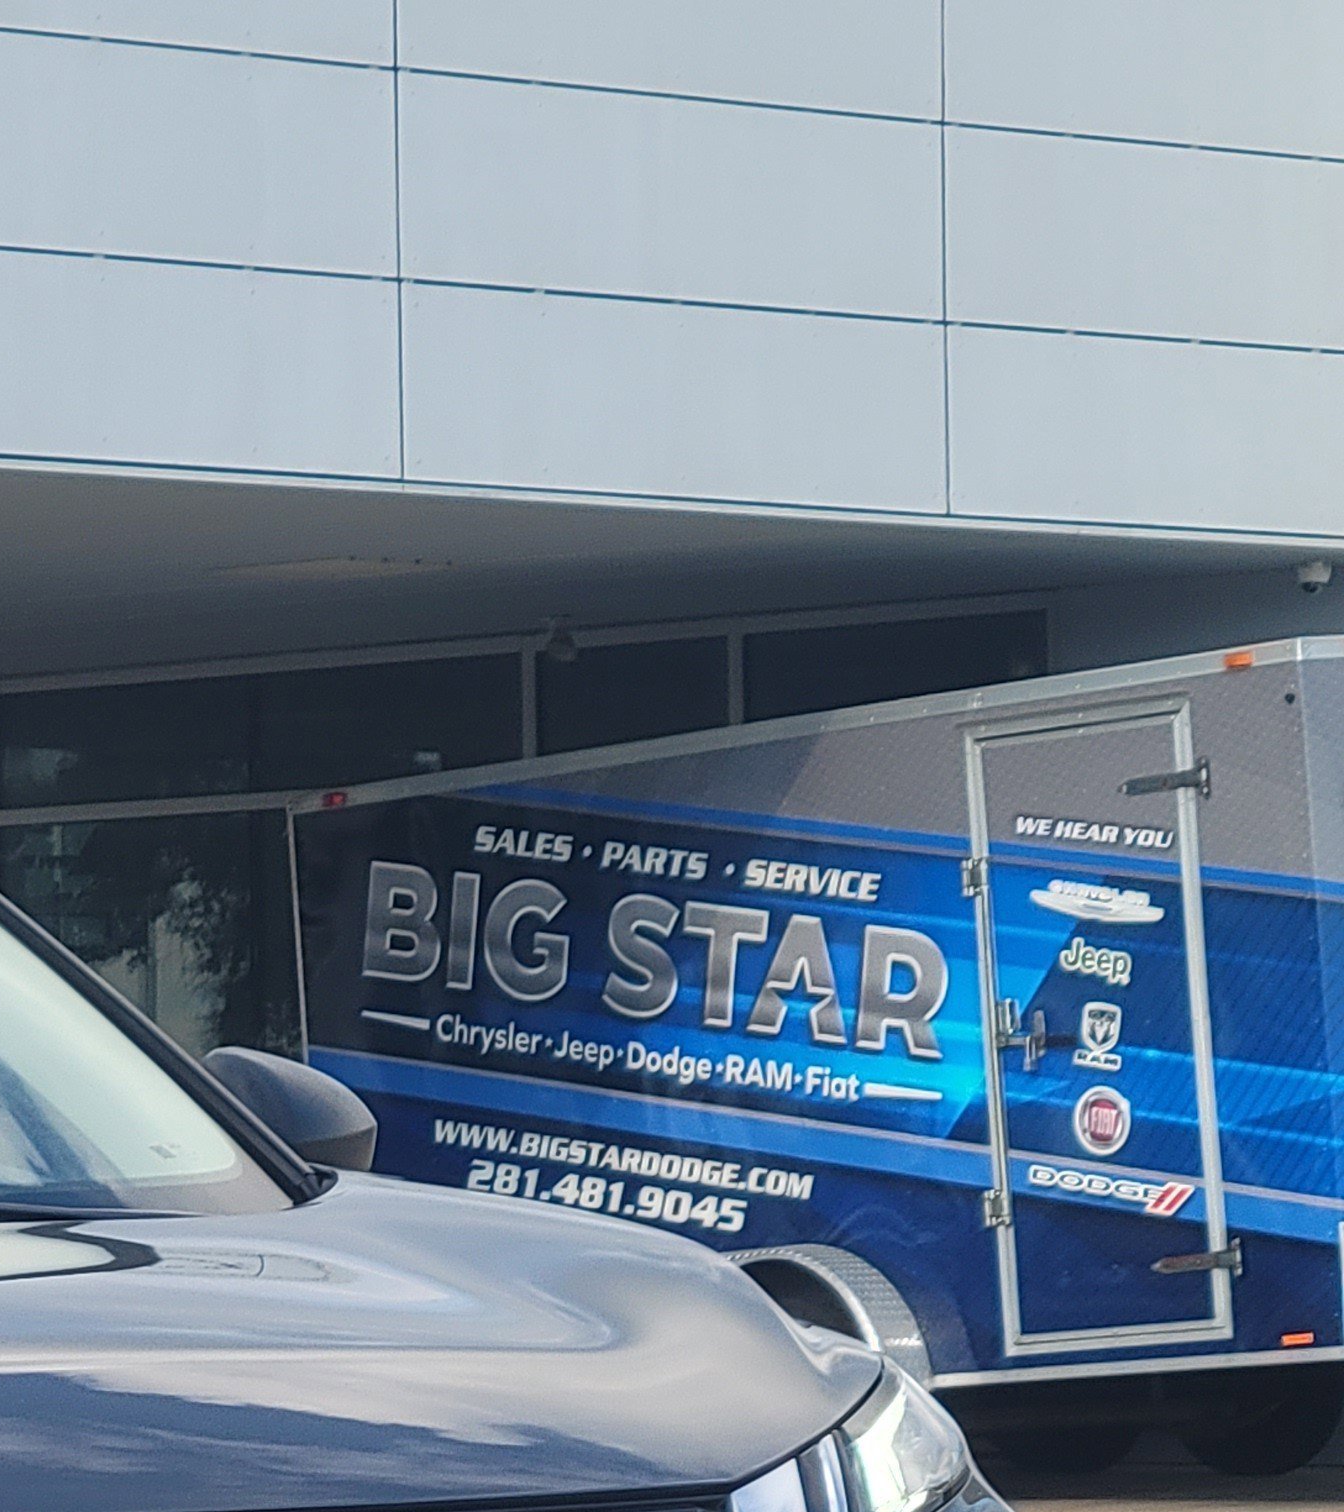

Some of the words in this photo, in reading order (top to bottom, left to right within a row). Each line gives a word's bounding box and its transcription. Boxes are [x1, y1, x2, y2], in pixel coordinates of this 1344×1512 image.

[474, 826, 574, 864] SALES
[601, 841, 708, 881] PARTS
[744, 858, 881, 902] SERVICE
[1016, 816, 1053, 836] WE
[1053, 820, 1119, 843] HEAR
[1123, 827, 1174, 848] YOU
[362, 860, 570, 1003] BIG
[602, 893, 950, 1060] STAR
[1062, 938, 1131, 982] Jeep
[434, 1118, 815, 1200] WWW.BIGSTARDODGE.COM
[467, 1158, 749, 1233] 281.481.9045
[1031, 1166, 1164, 1198] DODGE
